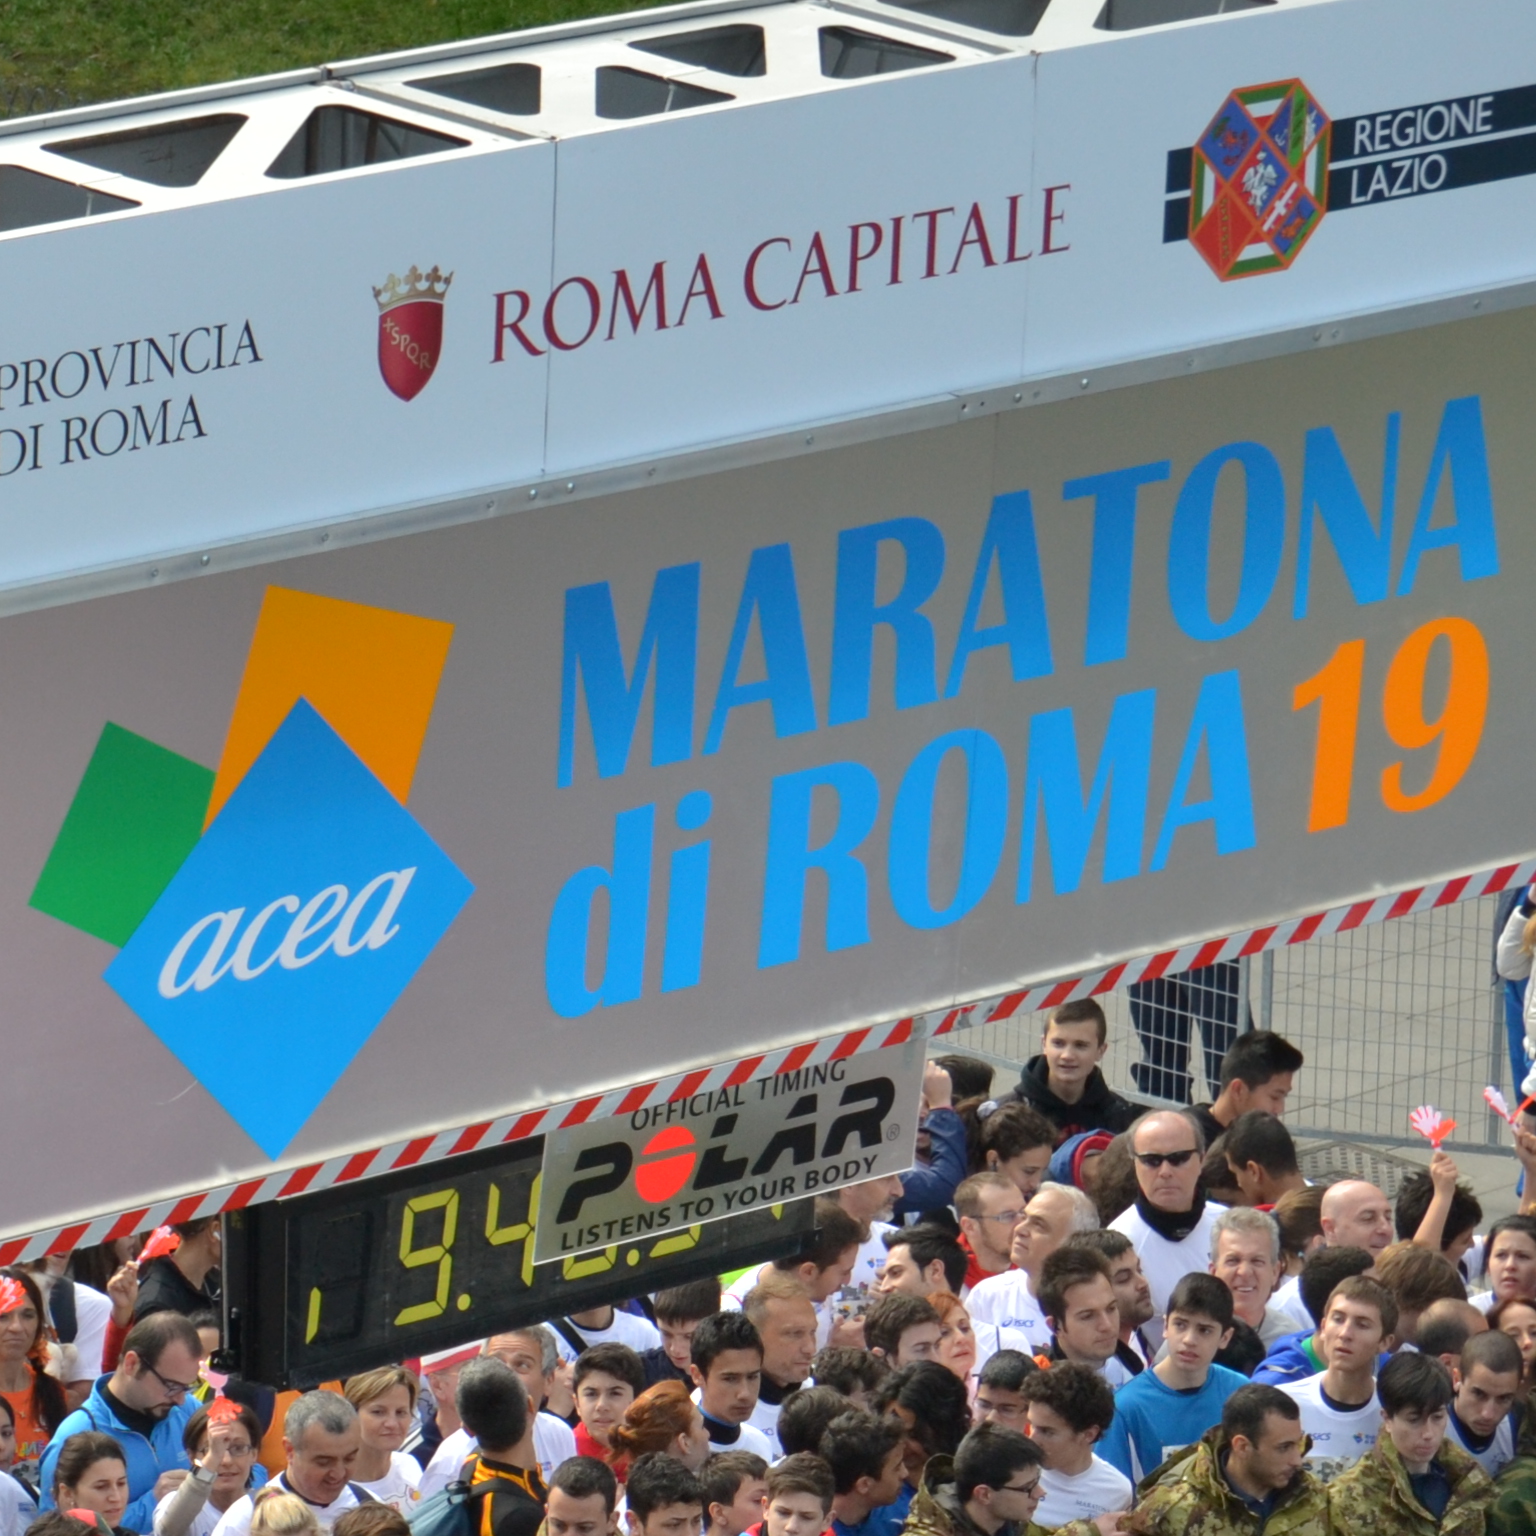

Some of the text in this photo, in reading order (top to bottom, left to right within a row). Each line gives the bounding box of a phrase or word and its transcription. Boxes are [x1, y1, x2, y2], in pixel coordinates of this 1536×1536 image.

[1353, 97, 1494, 155] REGIONE
[1350, 152, 1448, 204] LAZIO
[489, 183, 1073, 365] ROMA CAPITALE
[58, 395, 208, 466] ROMA
[556, 393, 1501, 790] MARATONA
[544, 615, 1491, 1019] di ROMA 19
[156, 864, 418, 1000] acea
[630, 1058, 847, 1133] OFFICIAL TIMING
[561, 1154, 878, 1251] LISTENS TO YOUR BODY
